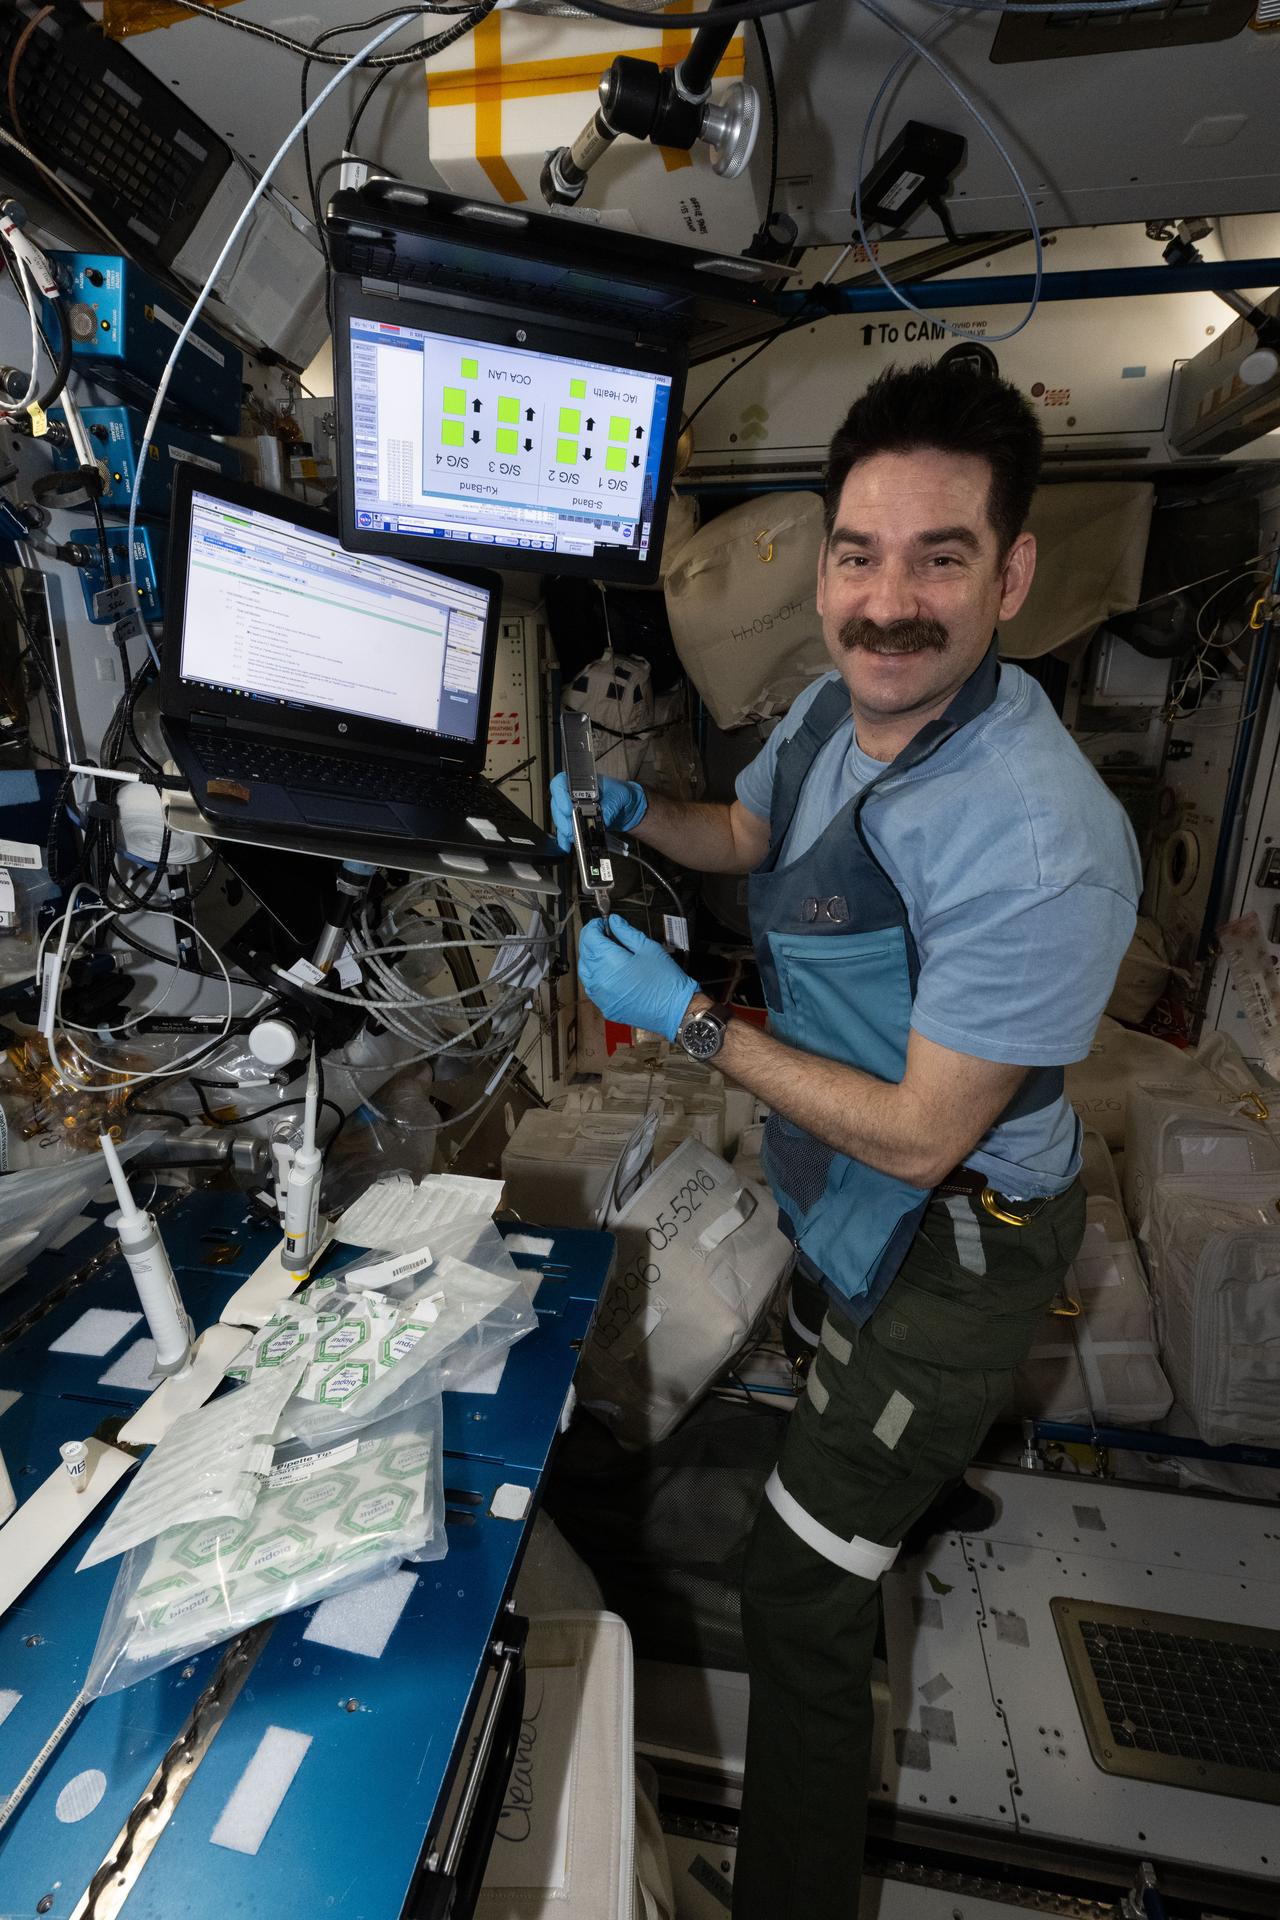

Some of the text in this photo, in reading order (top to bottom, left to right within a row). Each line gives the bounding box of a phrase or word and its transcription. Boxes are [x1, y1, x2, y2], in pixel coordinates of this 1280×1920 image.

[878, 320, 946, 344] To CAM
[488, 368, 532, 386] OCA LAN
[593, 387, 620, 402] Health
[435, 453, 469, 469] S/G 4
[488, 460, 521, 476] S/G 3
[548, 469, 580, 485] S/G 2
[598, 476, 628, 492] S/G 1
[460, 482, 498, 495] Ku-Band
[572, 497, 603, 509] S-Band
[331, 1336, 354, 1344] biopur
[331, 1379, 356, 1387] biopur
[276, 1453, 313, 1471] Pipette
[169, 1593, 210, 1620] biopur
